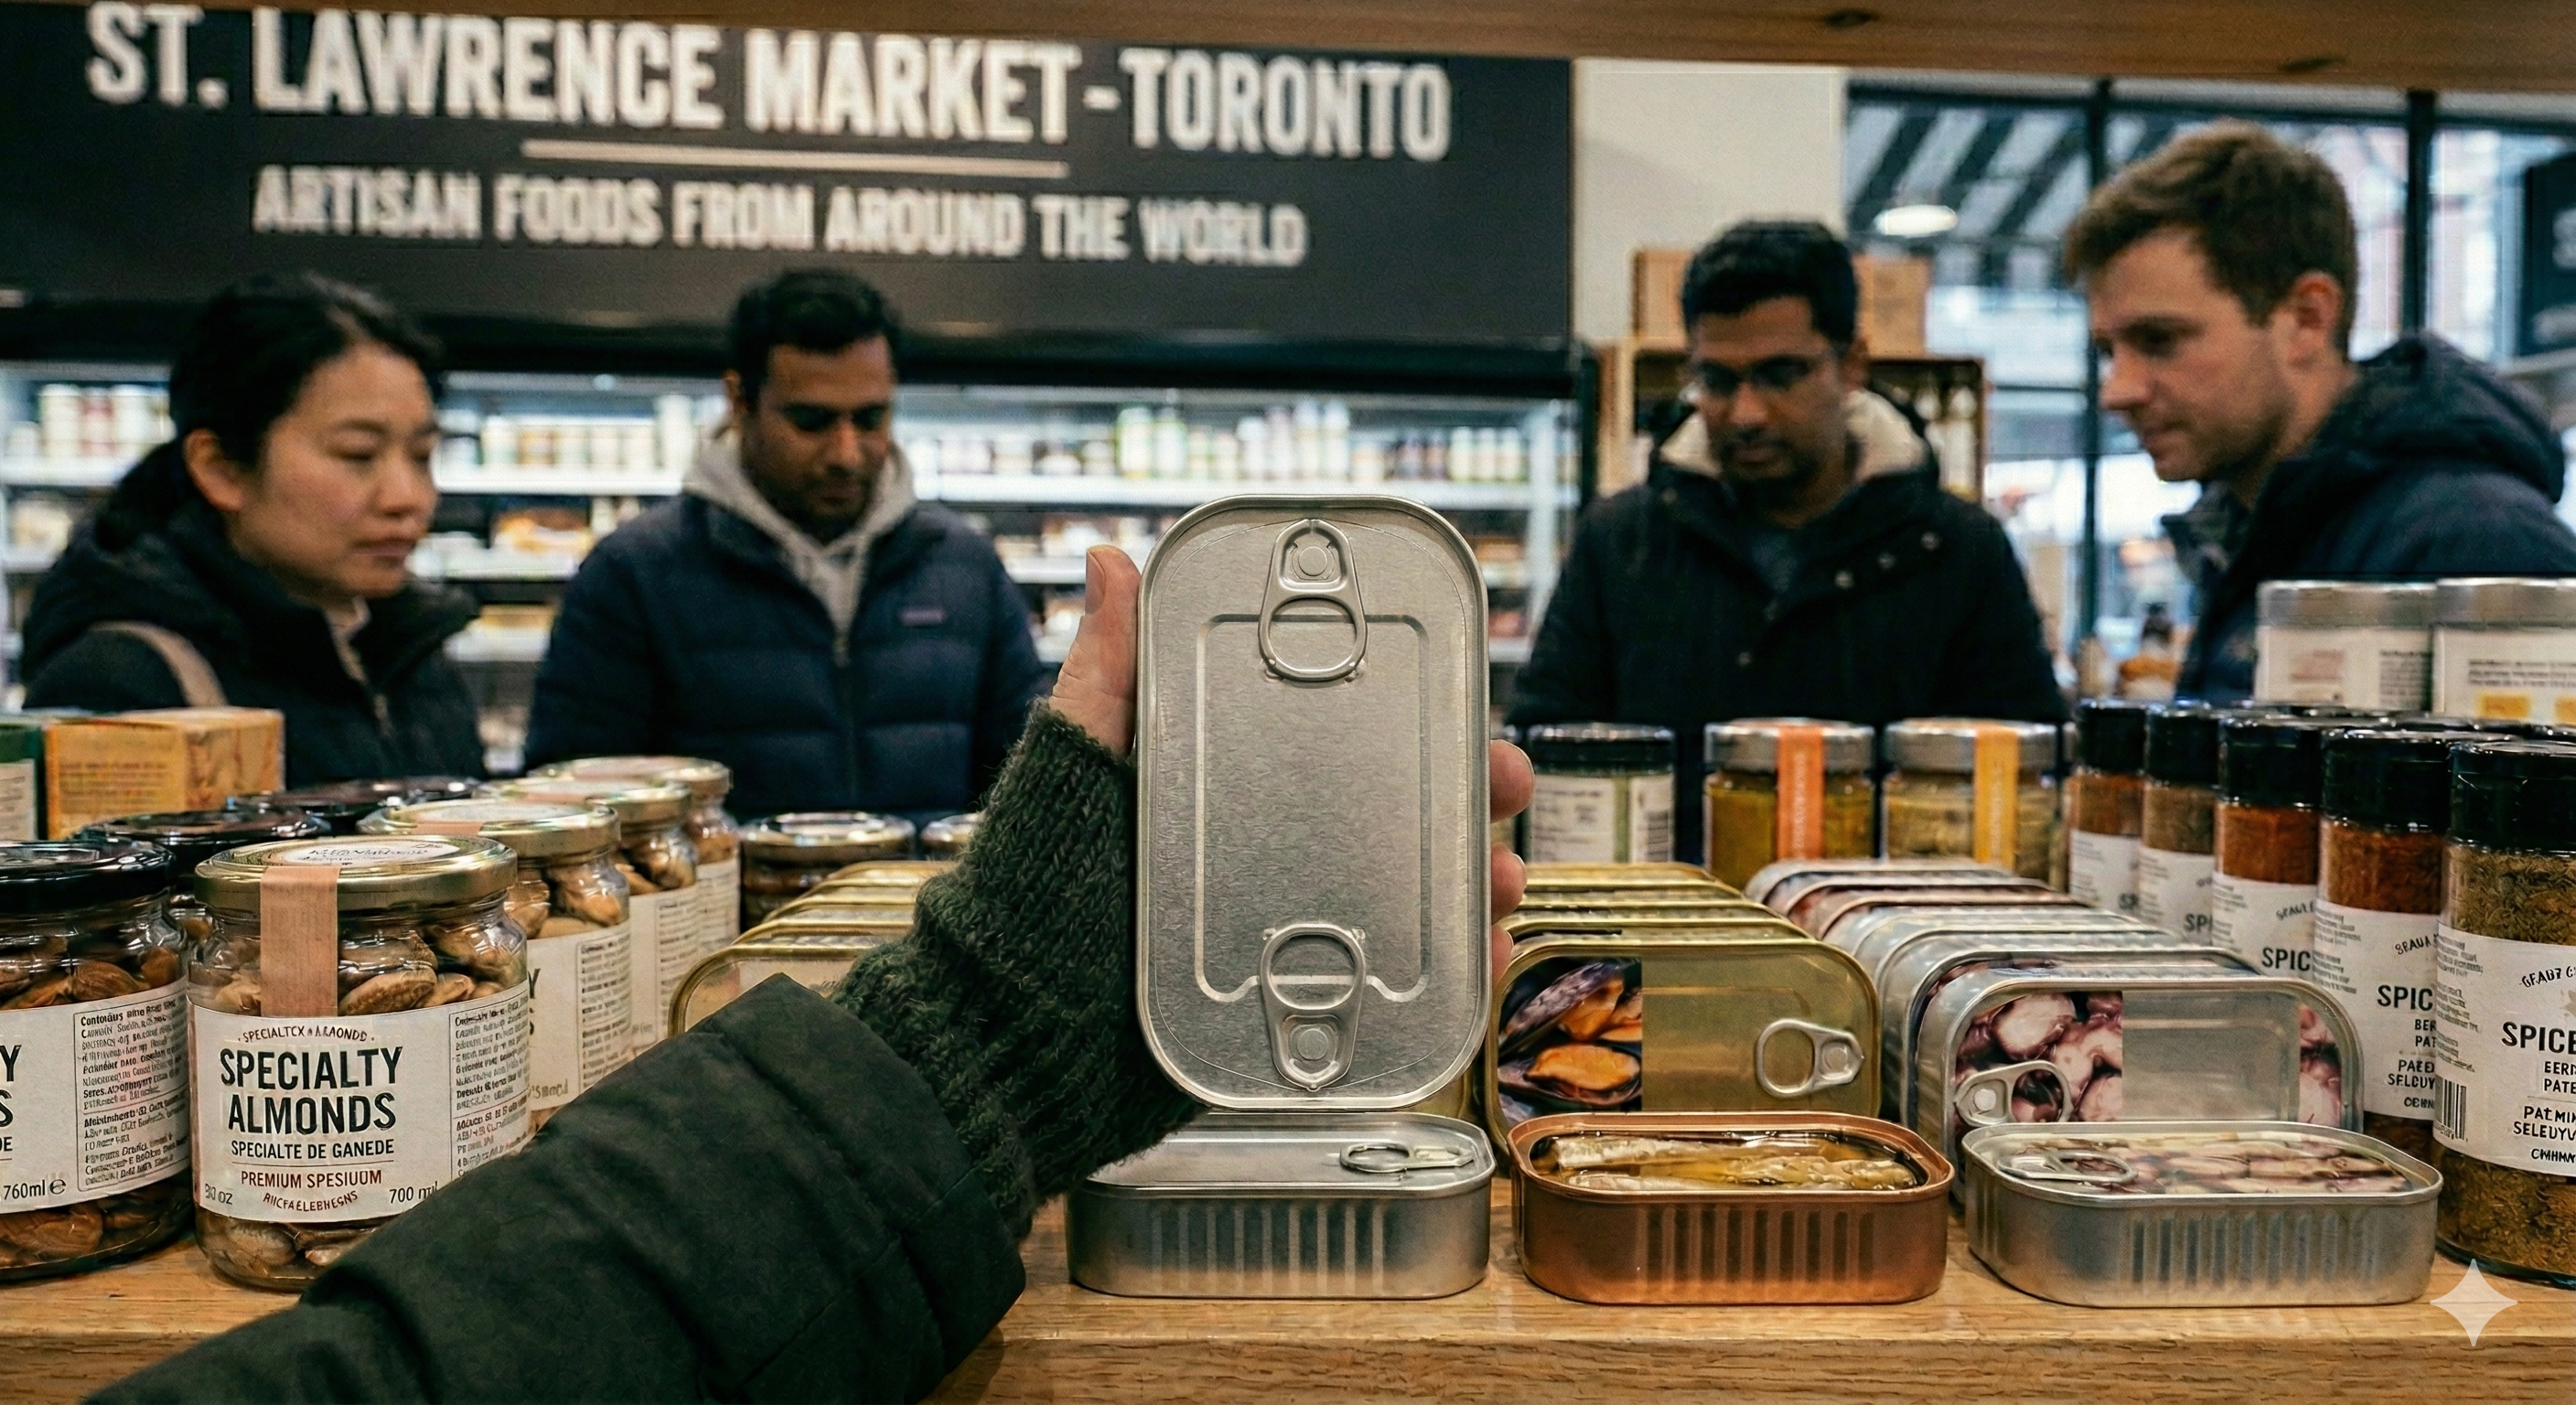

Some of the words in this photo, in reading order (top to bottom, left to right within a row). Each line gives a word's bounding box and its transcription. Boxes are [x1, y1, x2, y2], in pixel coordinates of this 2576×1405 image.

[85, 2, 230, 108] ST.
[252, 5, 724, 130] LAWRENCE
[253, 166, 482, 236] ARTISAN
[494, 176, 663, 245] FOODS
[672, 183, 814, 251] FROM
[823, 187, 1025, 257] AROUND
[1033, 196, 1130, 261] THE
[1140, 198, 1306, 266] WORLD
[220, 1046, 403, 1090] SPECIALTY
[228, 1092, 396, 1135] ALMONDS
[231, 1140, 302, 1160] SPECIALTE
[307, 1143, 327, 1160] DE
[332, 1139, 394, 1158] GANEDE
[4, 1179, 46, 1200] 760ml
[241, 1170, 302, 1189] PREMIUM
[389, 1185, 414, 1204] 700
